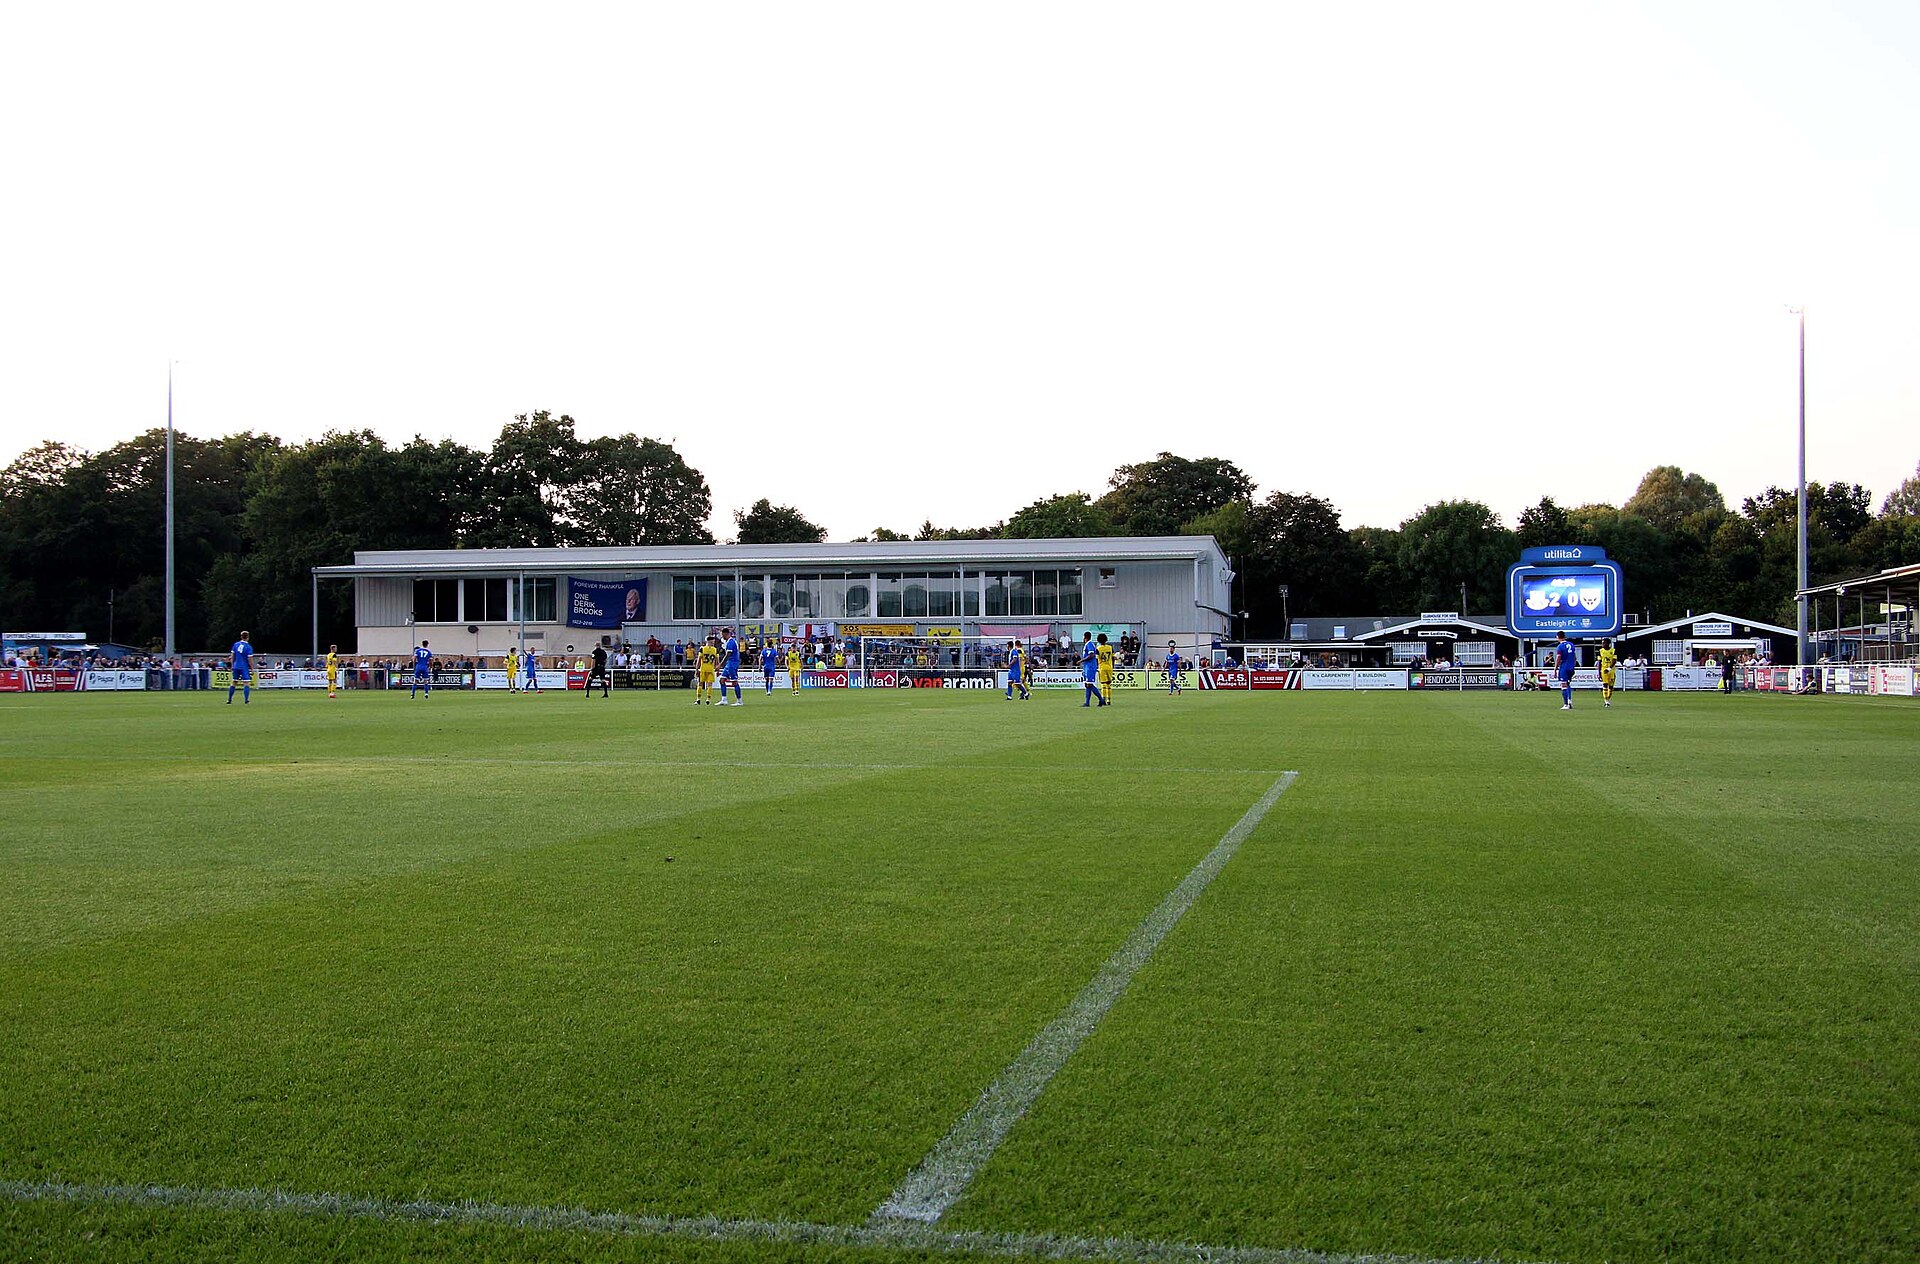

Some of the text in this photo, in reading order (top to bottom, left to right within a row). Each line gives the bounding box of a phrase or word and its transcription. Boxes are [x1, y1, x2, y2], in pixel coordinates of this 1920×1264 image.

[1544, 550, 1572, 559] utilita
[574, 581, 597, 589] FOREVER
[574, 592, 589, 601] ONE
[1549, 592, 1578, 607] 2 0
[574, 600, 595, 608] DERIK
[573, 607, 603, 616] BROOKS
[1536, 620, 1567, 628] Eastleigh
[1566, 644, 1572, 653] 2
[419, 650, 429, 658] 17
[703, 653, 716, 664] 39
[765, 650, 772, 658] 7
[216, 673, 230, 681] SOS
[402, 676, 416, 684] HEND
[446, 676, 461, 684] STORE
[636, 673, 683, 681] DesireDramVision
[803, 676, 836, 687] utilita
[1161, 673, 1187, 681] SS
[1217, 673, 1247, 682] A.F.S.
[1425, 675, 1444, 684] HENDY
[1444, 675, 1458, 684] CAR
[1465, 675, 1478, 684] VAN
[1479, 675, 1497, 684] STORE
[913, 677, 994, 689] vanarama
